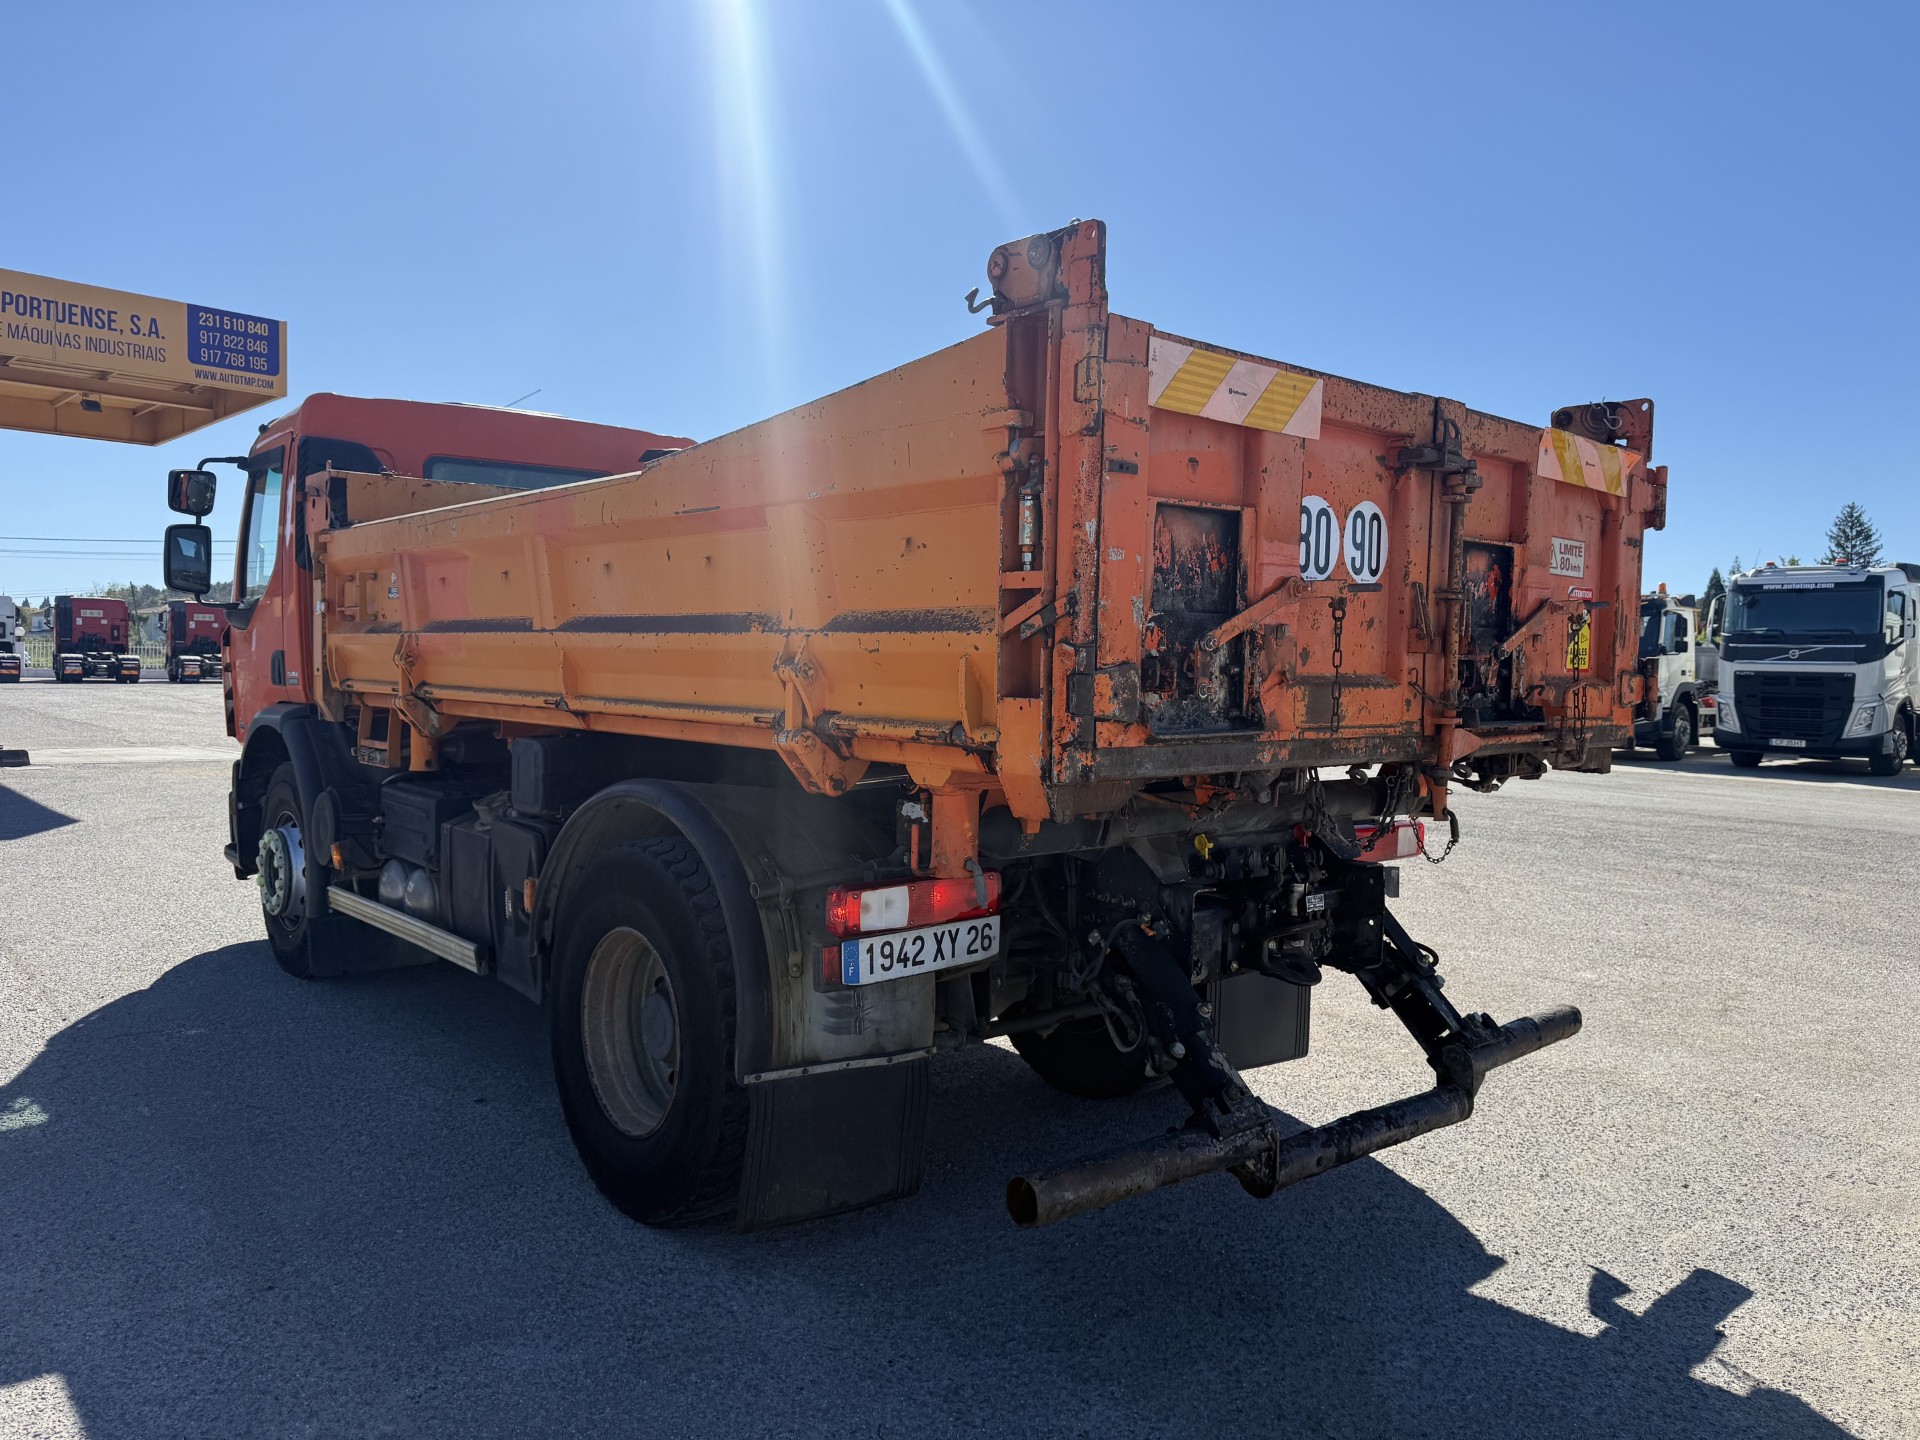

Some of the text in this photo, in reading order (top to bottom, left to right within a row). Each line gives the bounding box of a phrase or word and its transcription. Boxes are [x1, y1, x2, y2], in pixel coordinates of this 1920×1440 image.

[1, 290, 124, 335] PORTUENSE,
[129, 314, 165, 340] S.A.
[199, 312, 269, 336] 231 510 840
[7, 322, 81, 350] MÁQUINAS
[85, 336, 166, 363] INDUSTRIAIS
[200, 330, 268, 354] 917 822 846
[200, 348, 268, 371] 917 768 195
[194, 368, 274, 390] WWW.AUTOTMP.COM
[1351, 510, 1381, 577] 90
[866, 923, 993, 975] 1942 XY 26
[849, 966, 854, 977] F
